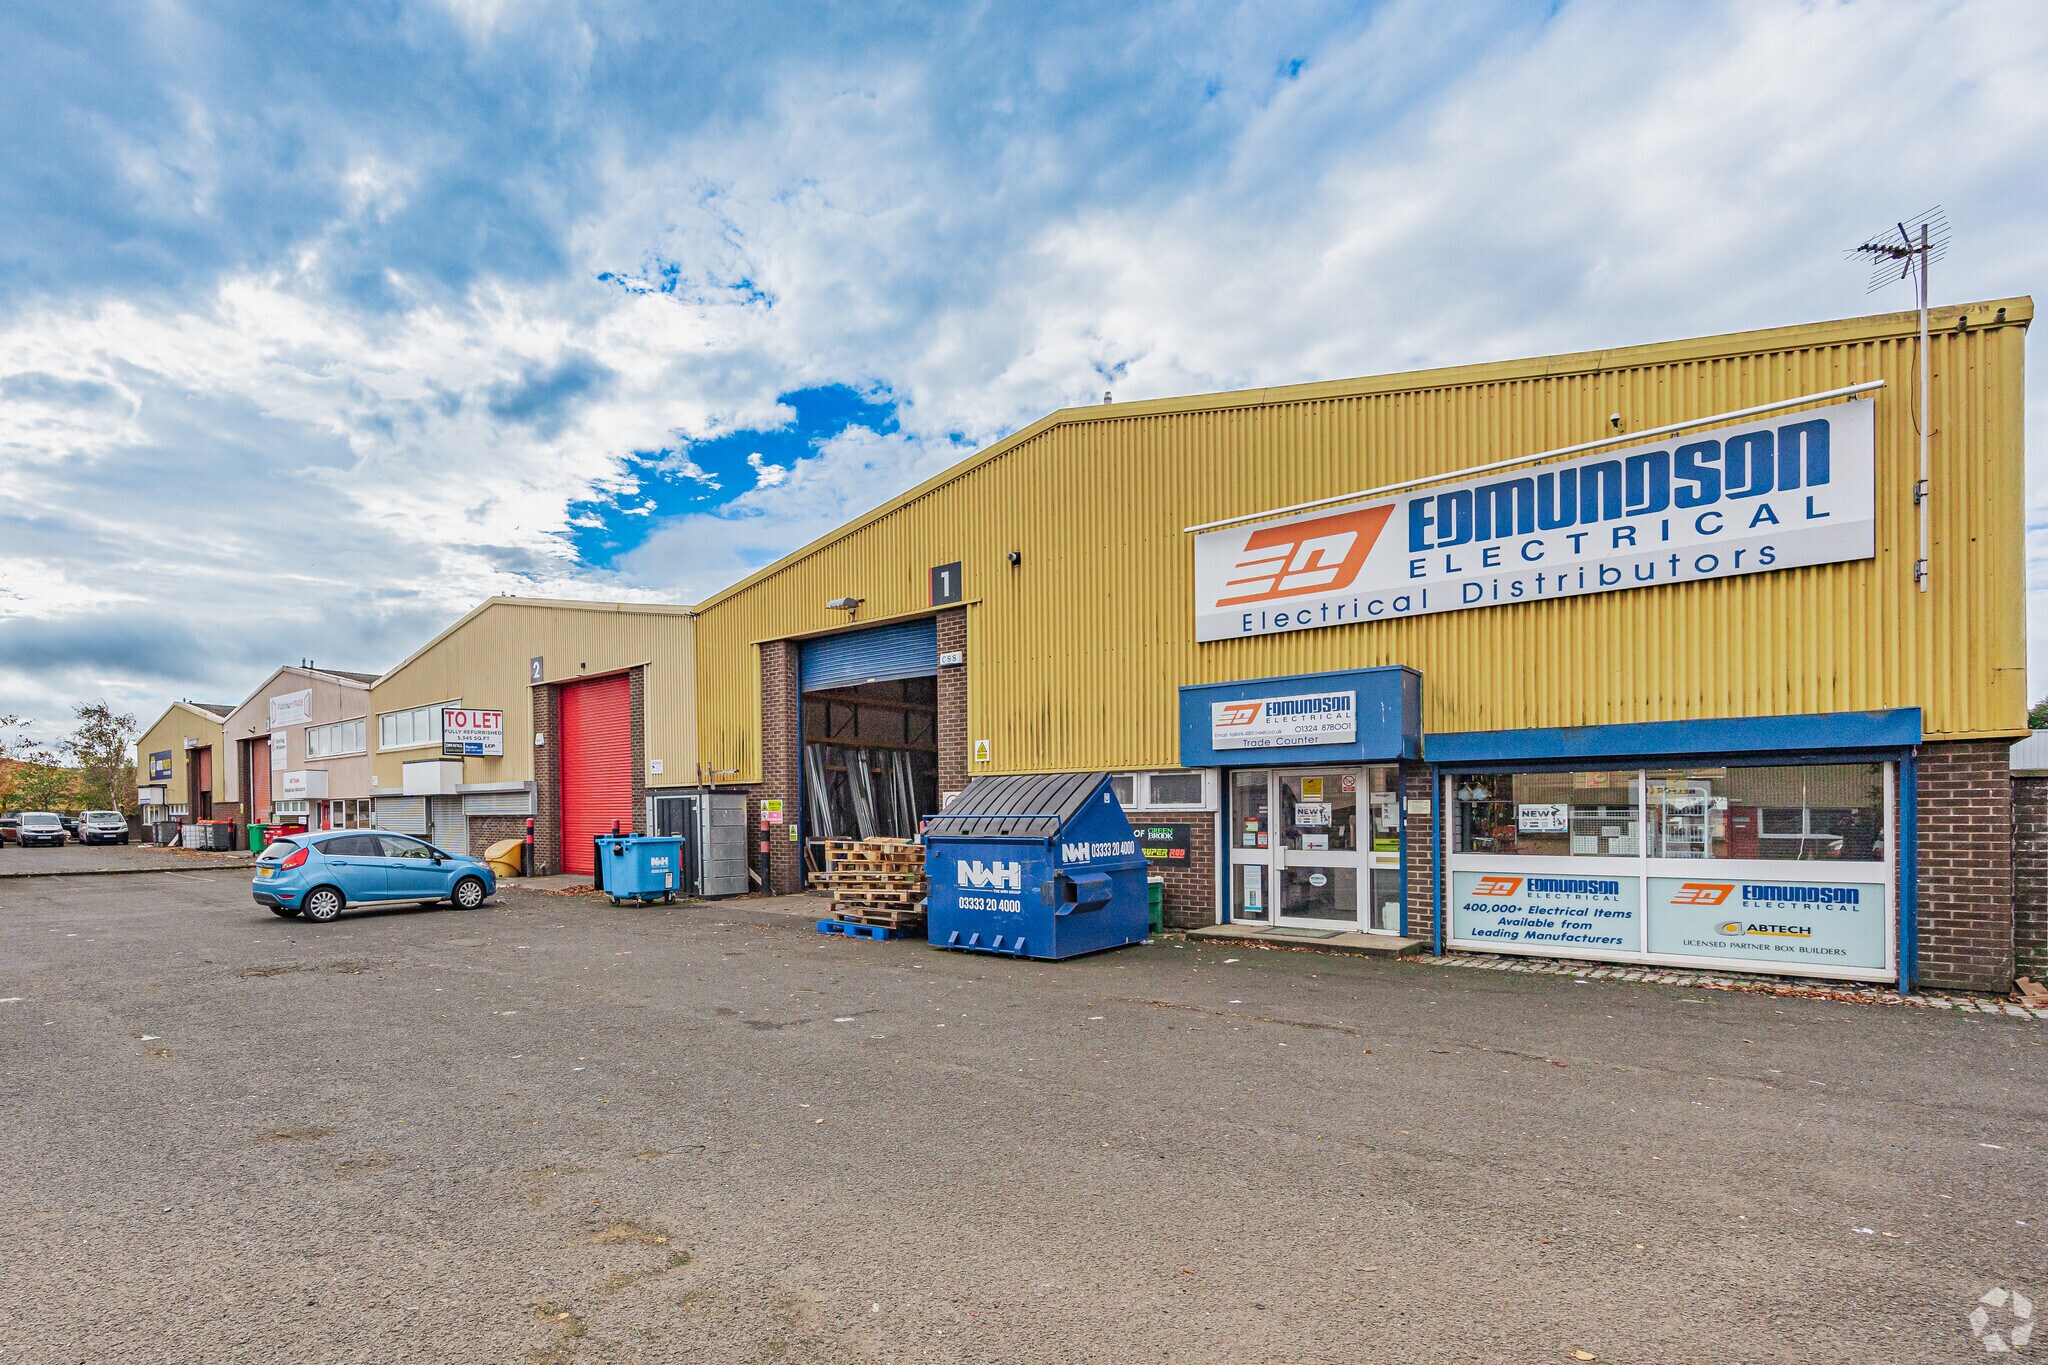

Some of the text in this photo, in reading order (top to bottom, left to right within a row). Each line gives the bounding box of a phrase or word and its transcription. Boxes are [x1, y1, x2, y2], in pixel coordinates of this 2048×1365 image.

[1408, 418, 1830, 553] EDMUNDSON
[1410, 496, 1830, 578] ELECTRICAL
[940, 571, 949, 597] 1
[1242, 542, 1776, 632] Electrical Distributors
[533, 661, 540, 679] 2
[1266, 695, 1351, 717] EDMUNDSON
[445, 711, 502, 729] TO LET
[1266, 712, 1351, 723] ELECTRICAL
[1294, 723, 1352, 733] 01324 878001
[1243, 736, 1319, 747] Trade Counter
[1133, 829, 1145, 838] OF
[1061, 840, 1135, 862] NWH 03333 20 4000
[1141, 848, 1185, 858] SUPER ROD
[957, 860, 1022, 889] NWH
[1527, 878, 1619, 895] EDMUNDSON
[1742, 885, 1859, 904] EDMUNDSON
[958, 896, 1021, 913] 03333 20 4000
[1527, 892, 1619, 902] ELECTRICAL
[1462, 903, 1632, 919] 400,000+ Electrical Items
[1743, 901, 1859, 912] ELECTRICAL
[1497, 917, 1593, 930] Available from
[1746, 923, 1811, 935] ABTECH
[1471, 928, 1623, 945] Leading Manufacturers
[1683, 939, 1727, 948] LICENSED
[1730, 942, 1770, 951] PARTNER
[1799, 946, 1847, 955] BUILDERS
